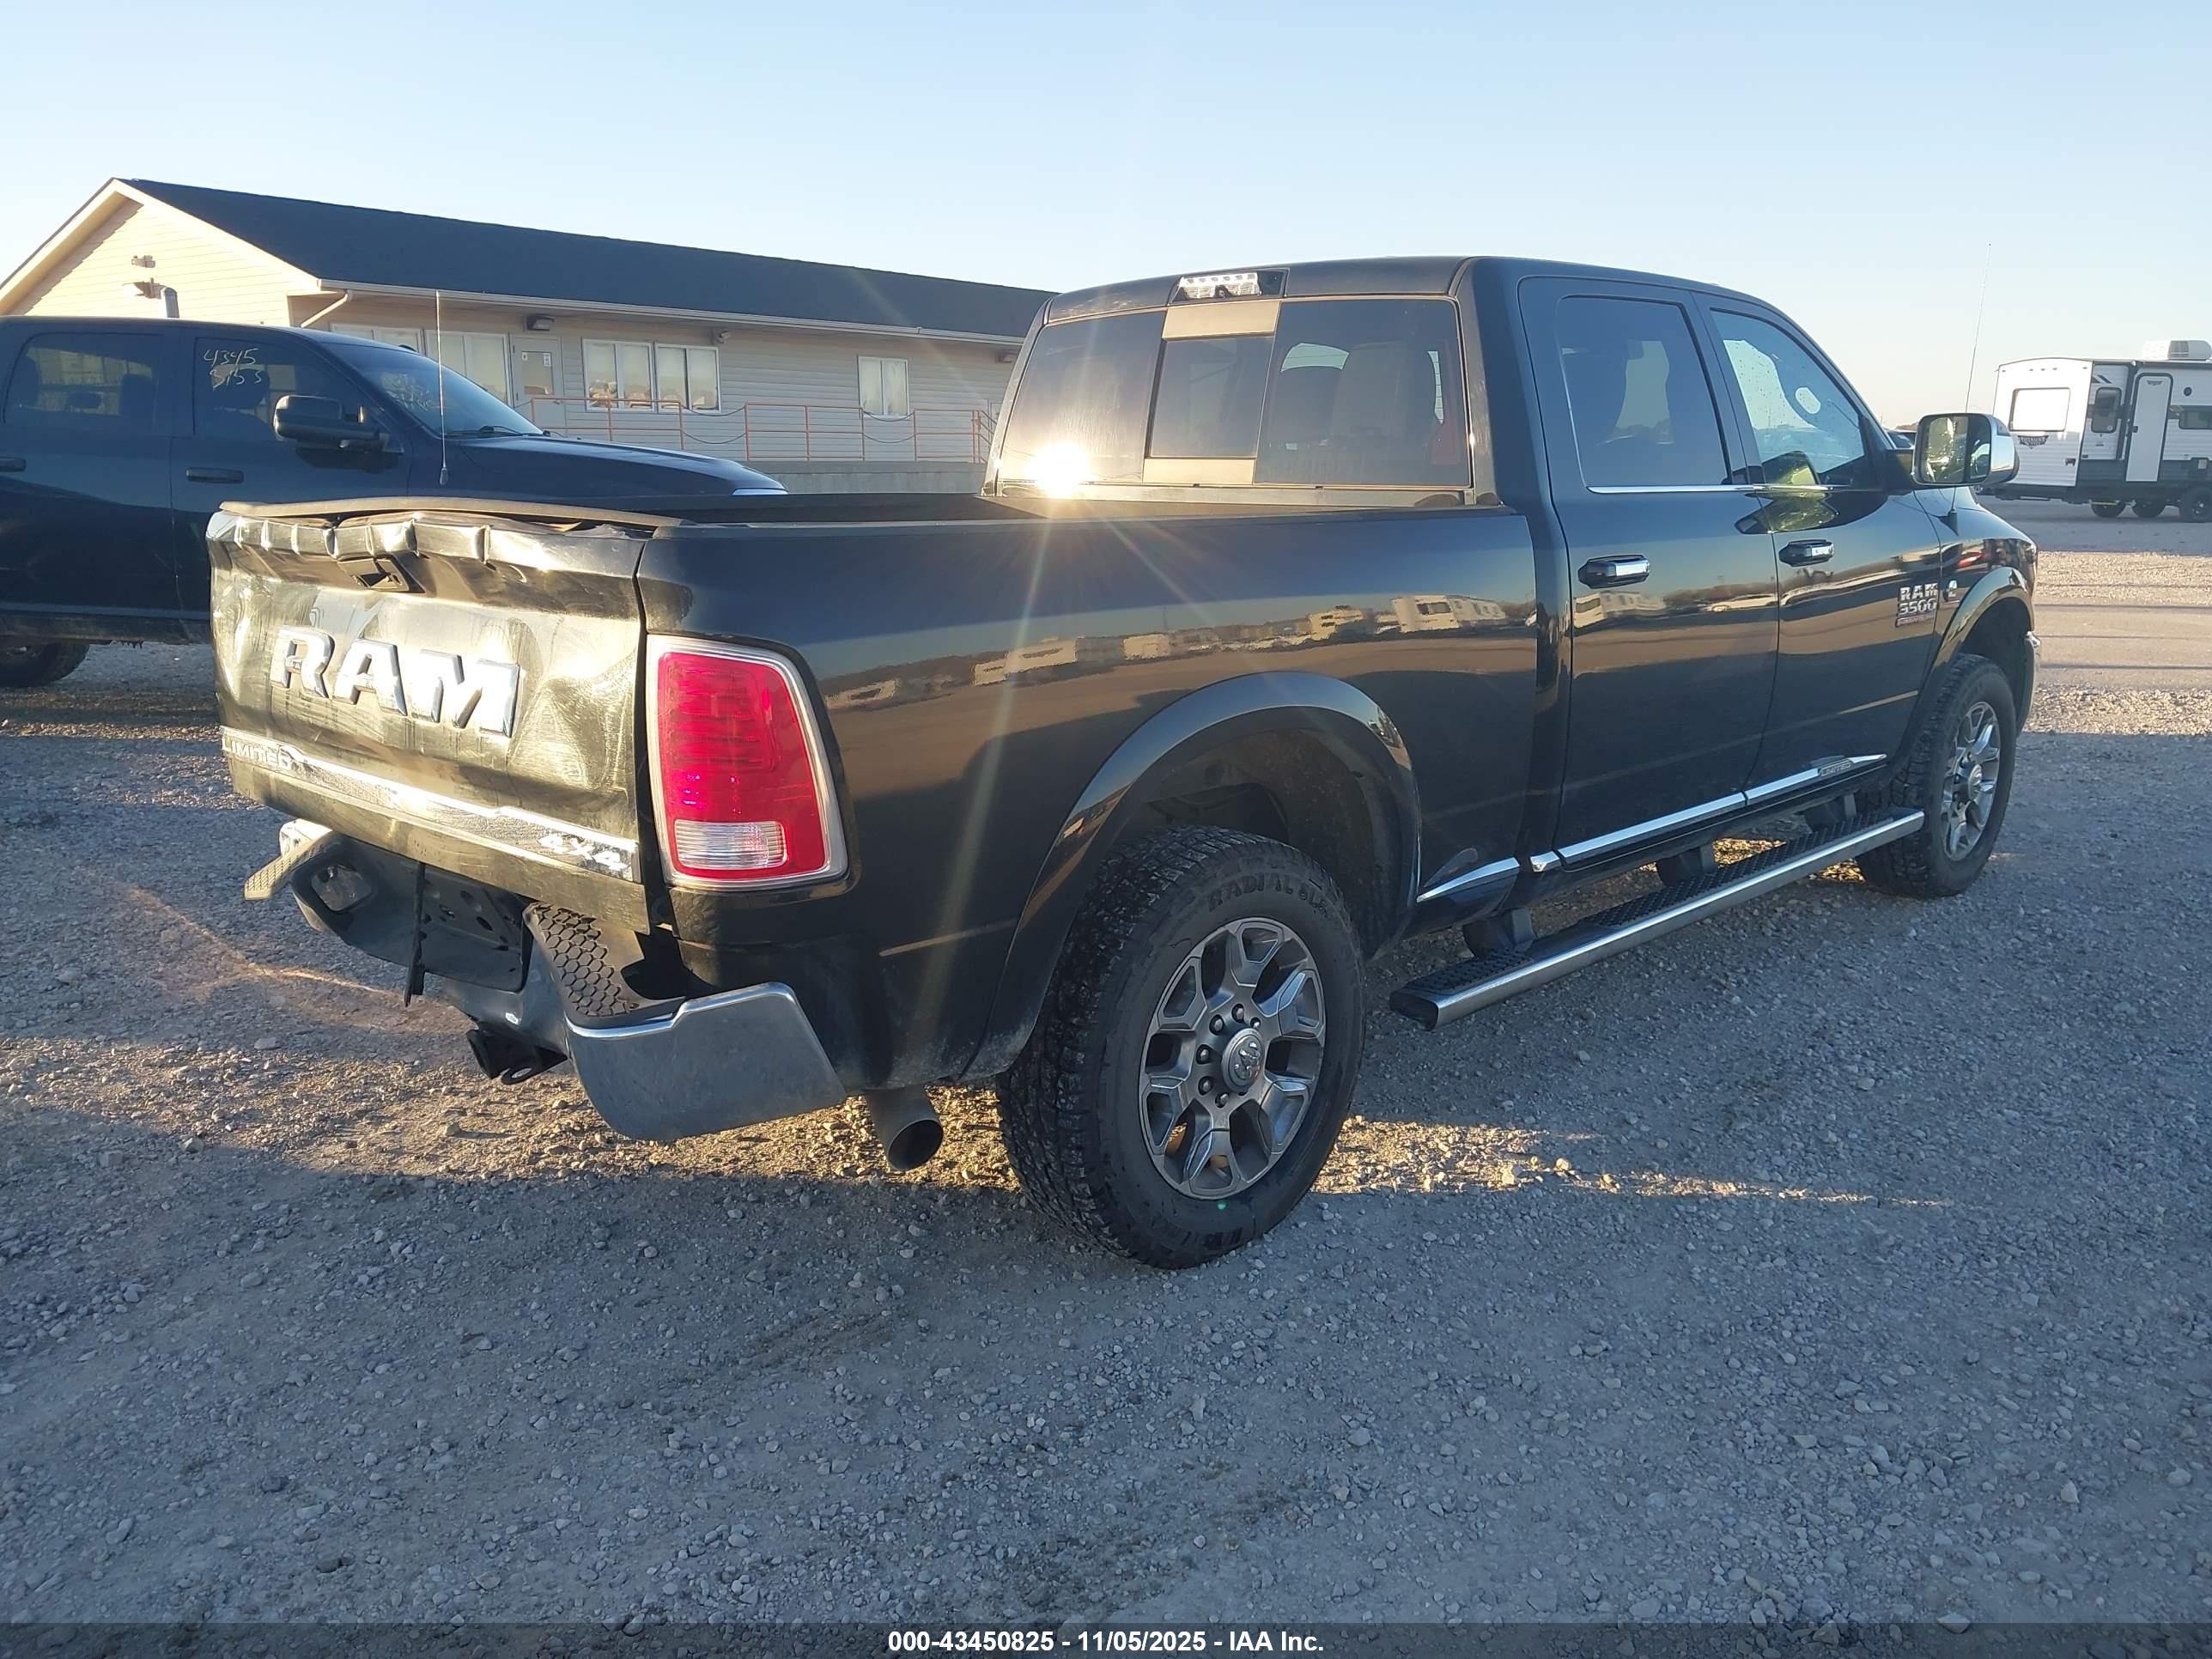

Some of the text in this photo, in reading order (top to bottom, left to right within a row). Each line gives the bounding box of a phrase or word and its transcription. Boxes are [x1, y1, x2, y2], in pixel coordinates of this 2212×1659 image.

[1898, 598, 1937, 616] 3500
[1899, 583, 1938, 601] RAM
[270, 625, 520, 738] RAM
[222, 736, 293, 771] LIMITED
[1208, 872, 1294, 912] RADIAL
